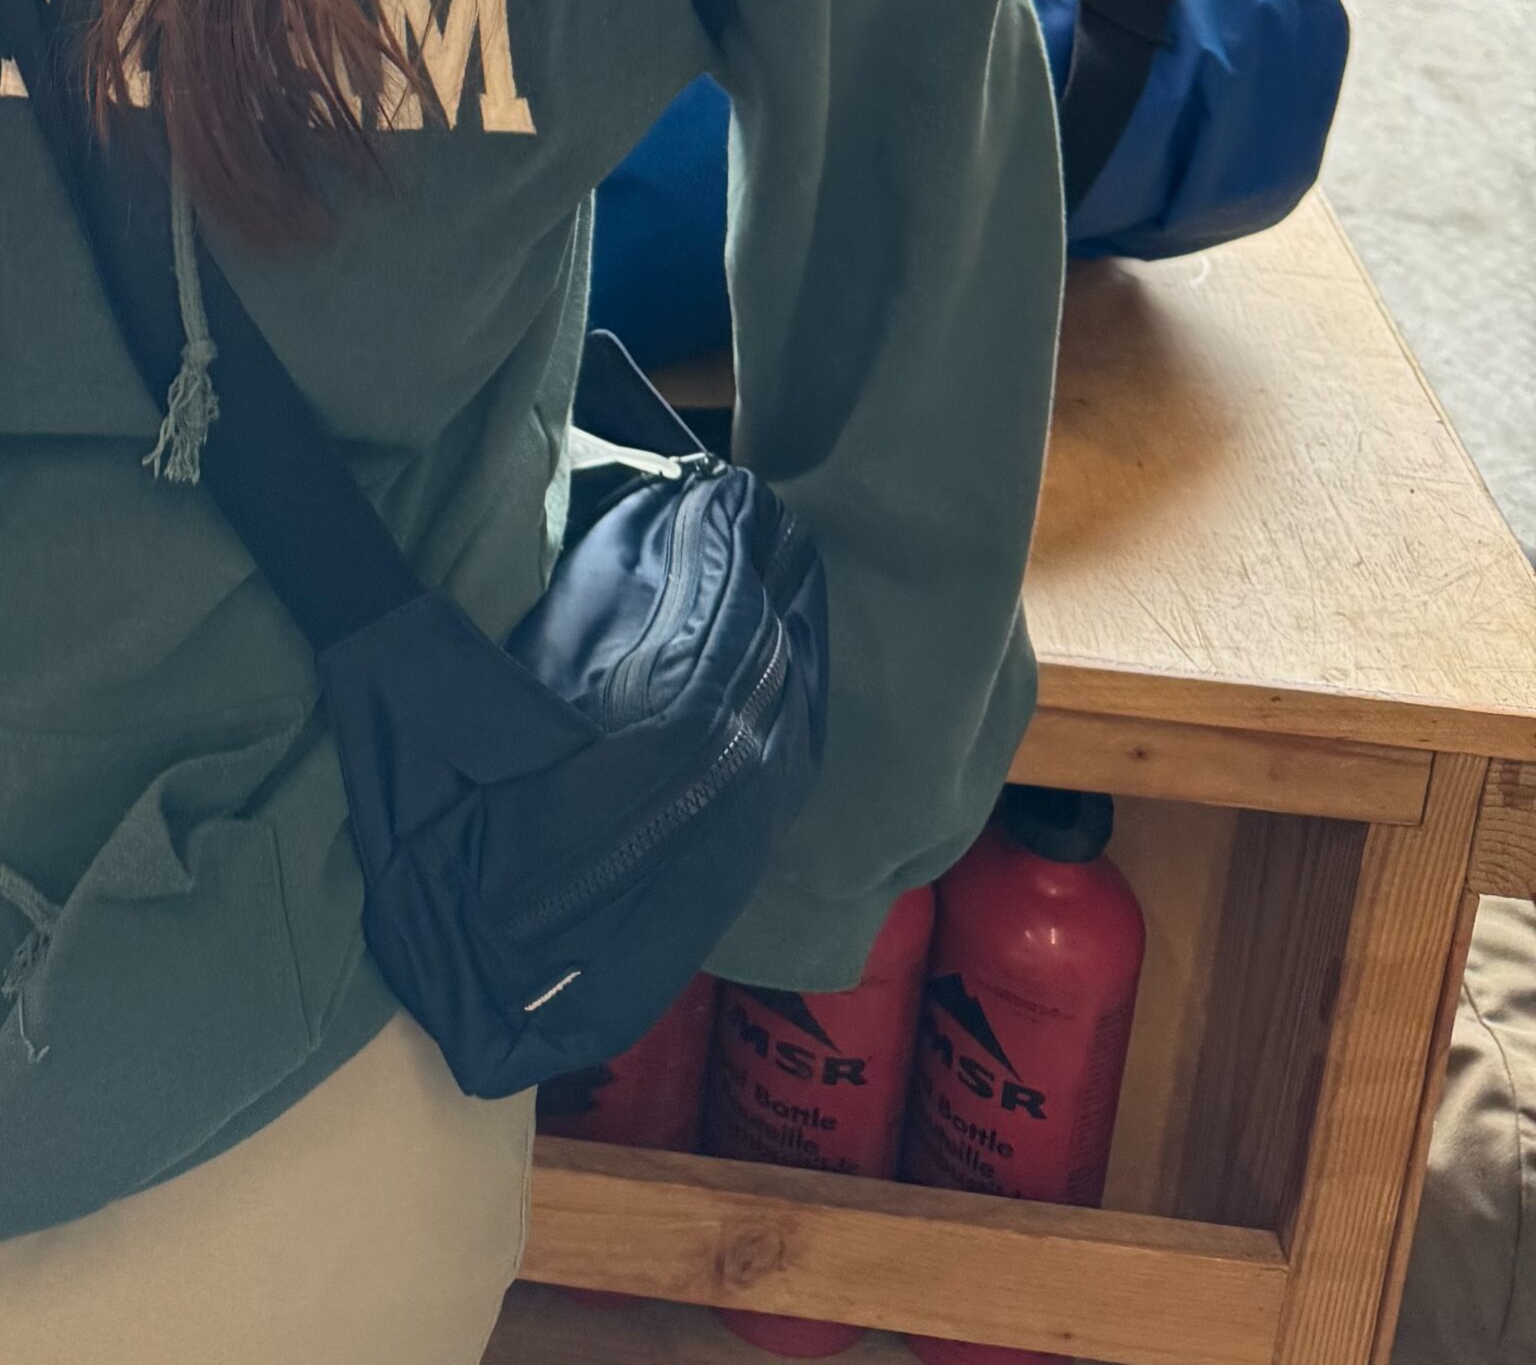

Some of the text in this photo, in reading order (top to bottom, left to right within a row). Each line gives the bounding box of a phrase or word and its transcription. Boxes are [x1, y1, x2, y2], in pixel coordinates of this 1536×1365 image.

[731, 1006, 868, 1087] MSR
[755, 1082, 838, 1131] Bottle
[938, 1094, 1013, 1157] Bottle
